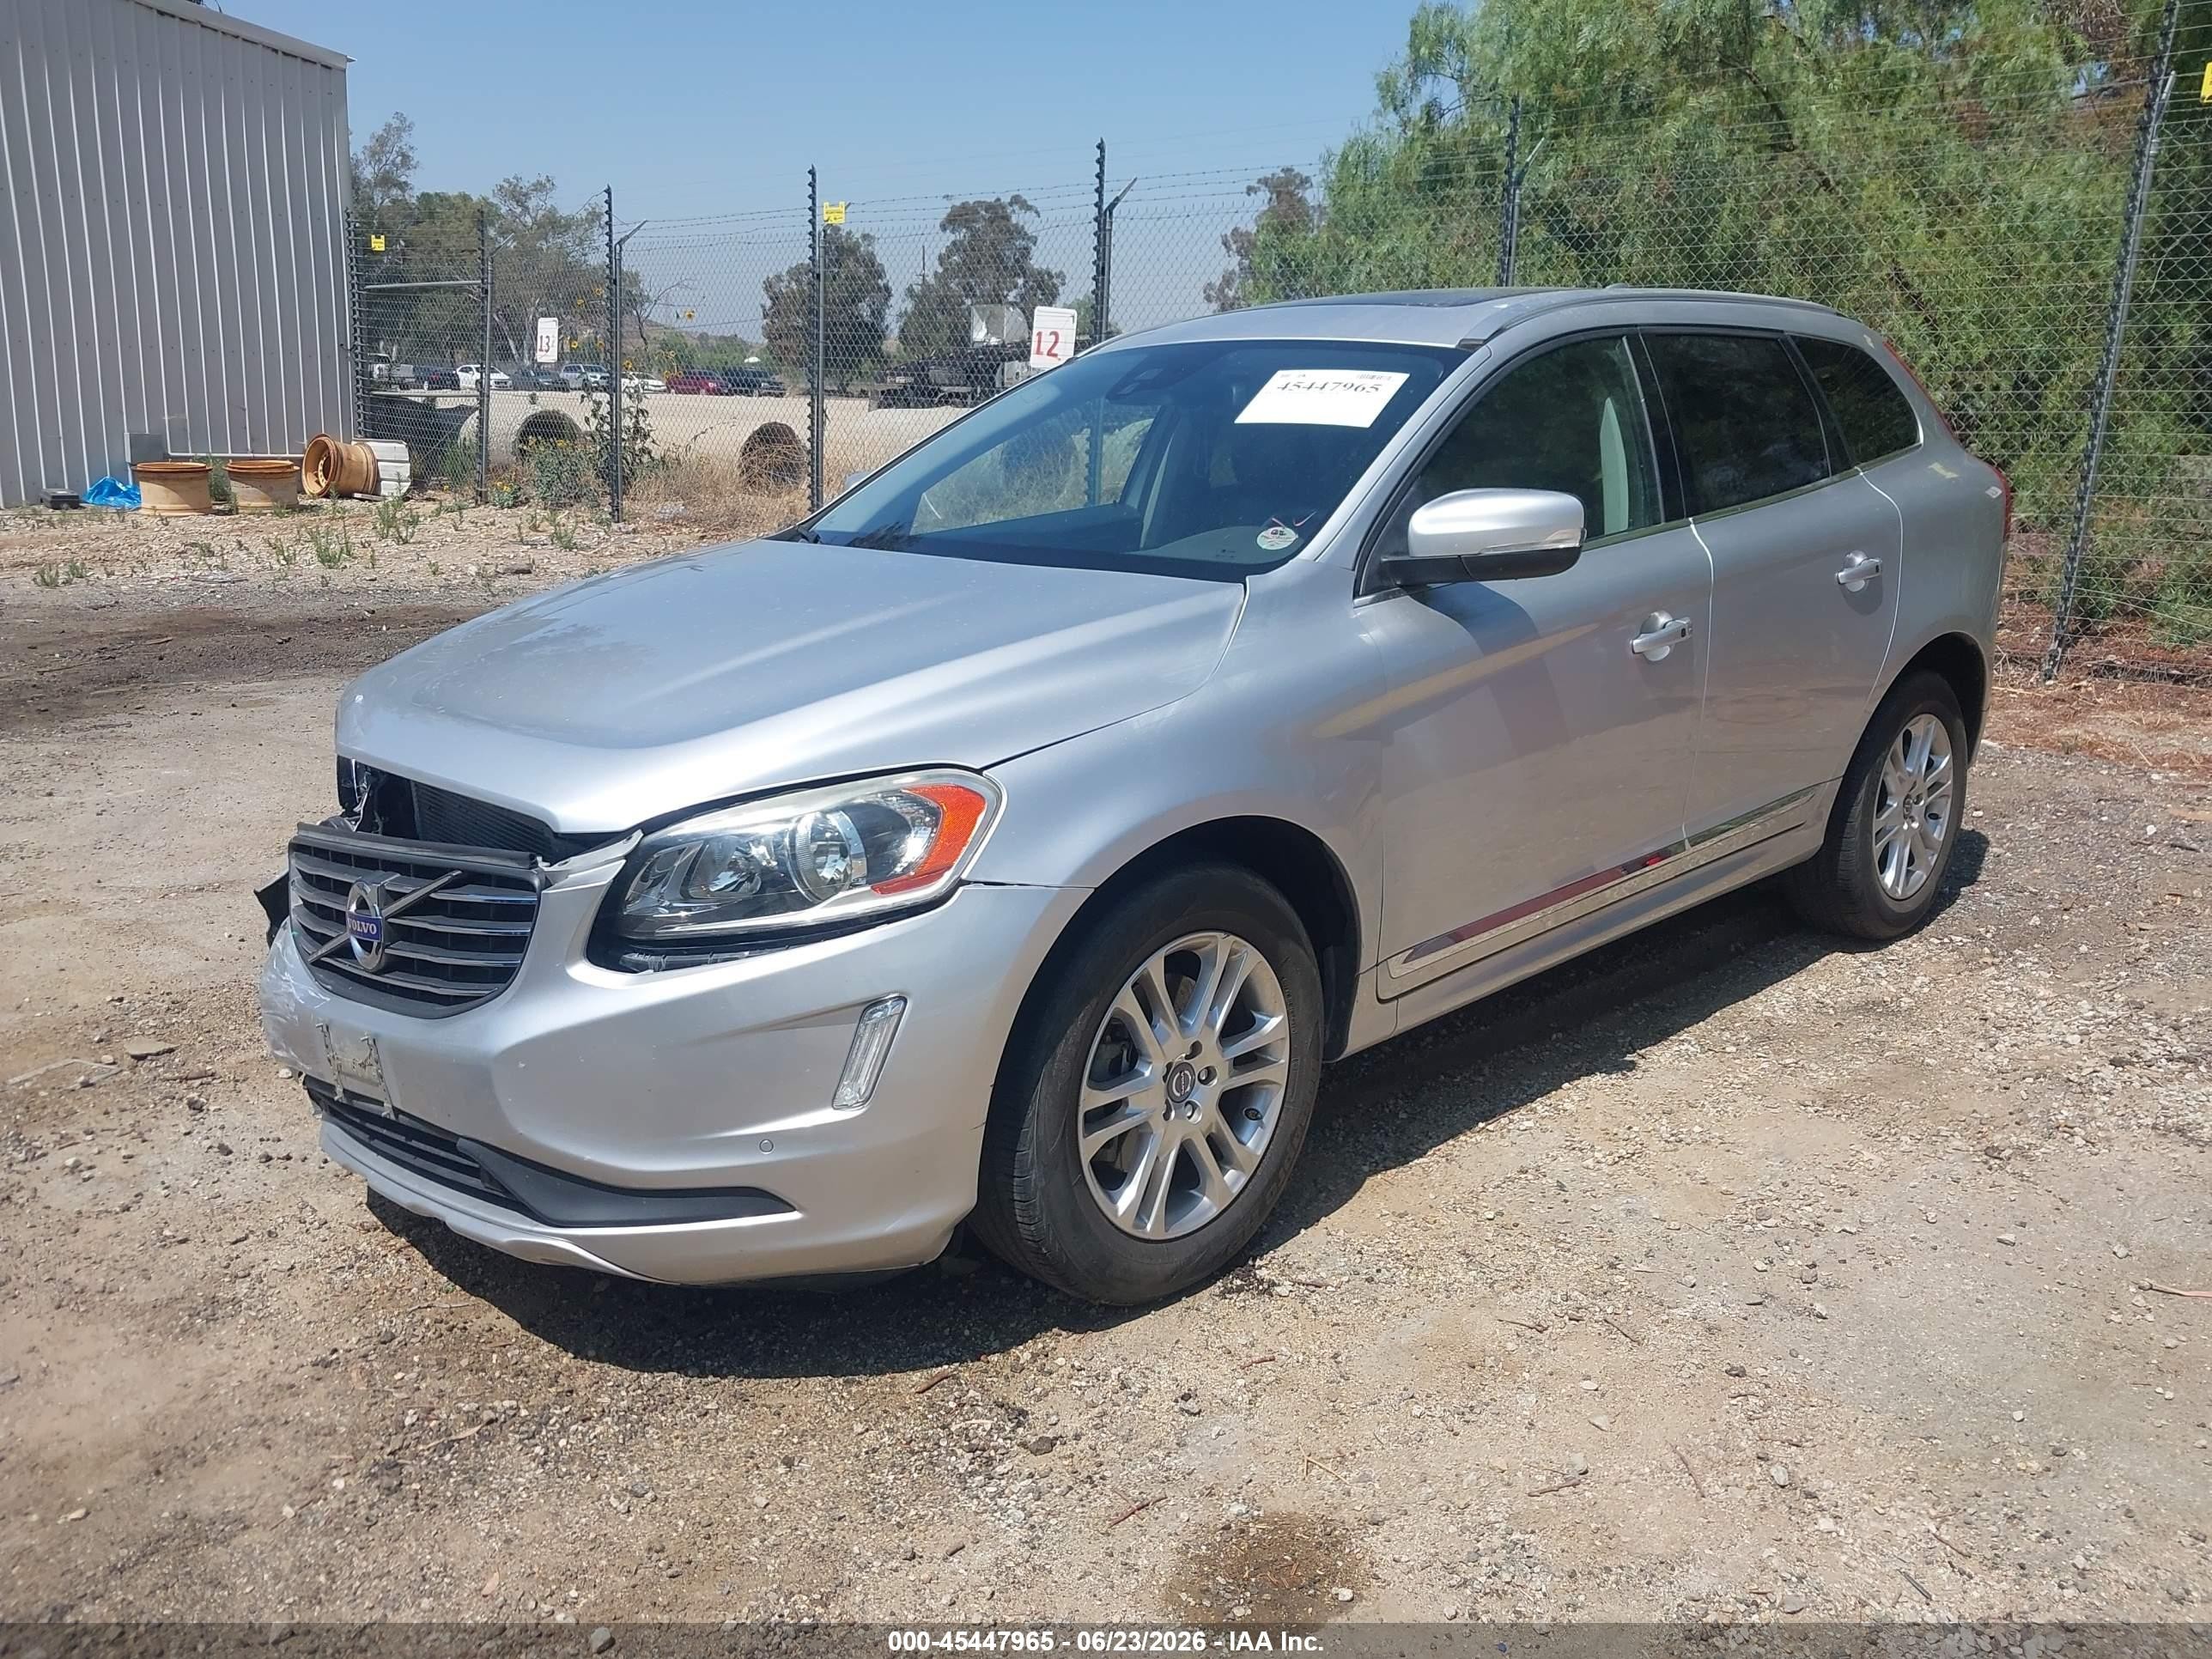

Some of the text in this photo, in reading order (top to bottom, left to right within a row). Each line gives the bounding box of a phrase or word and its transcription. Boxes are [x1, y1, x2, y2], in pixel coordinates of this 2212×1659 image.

[538, 335, 550, 353] 13
[1036, 331, 1060, 357] 12
[1277, 381, 1382, 393] 45447965
[347, 918, 377, 935] VOLVO
